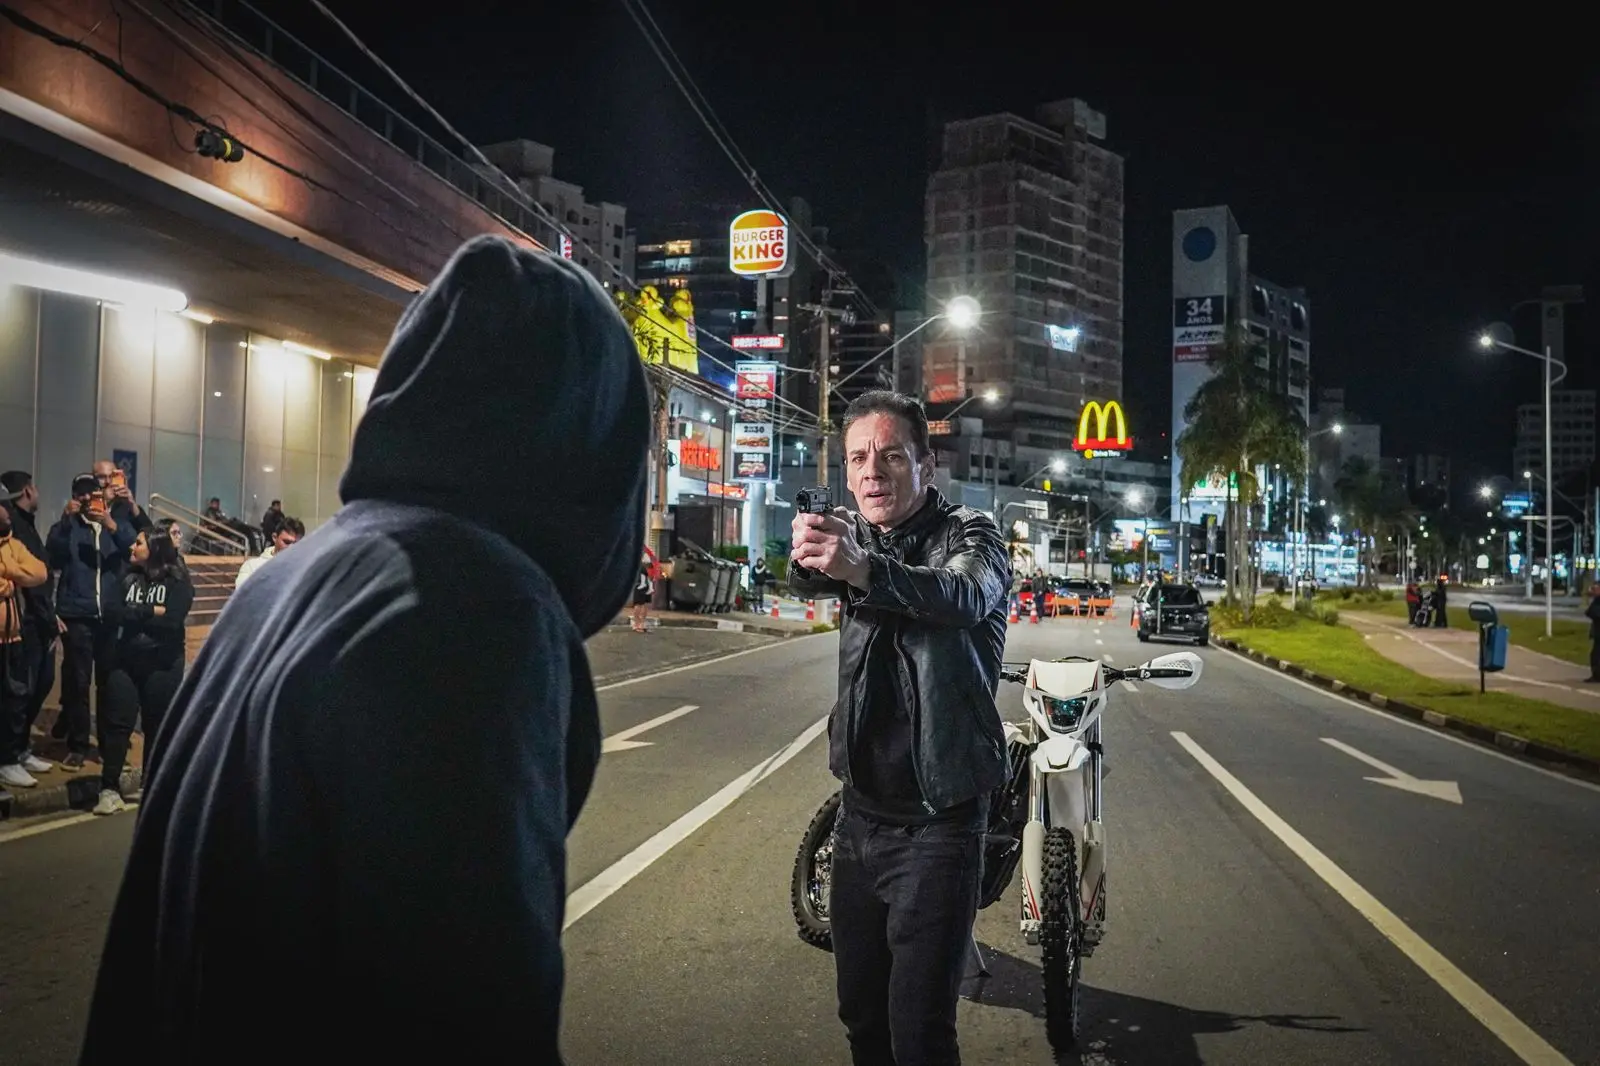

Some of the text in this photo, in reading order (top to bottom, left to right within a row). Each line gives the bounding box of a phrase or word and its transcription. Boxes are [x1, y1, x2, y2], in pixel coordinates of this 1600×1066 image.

[733, 229, 784, 242] BURGER
[734, 242, 784, 260] KING
[1186, 298, 1213, 316] 34
